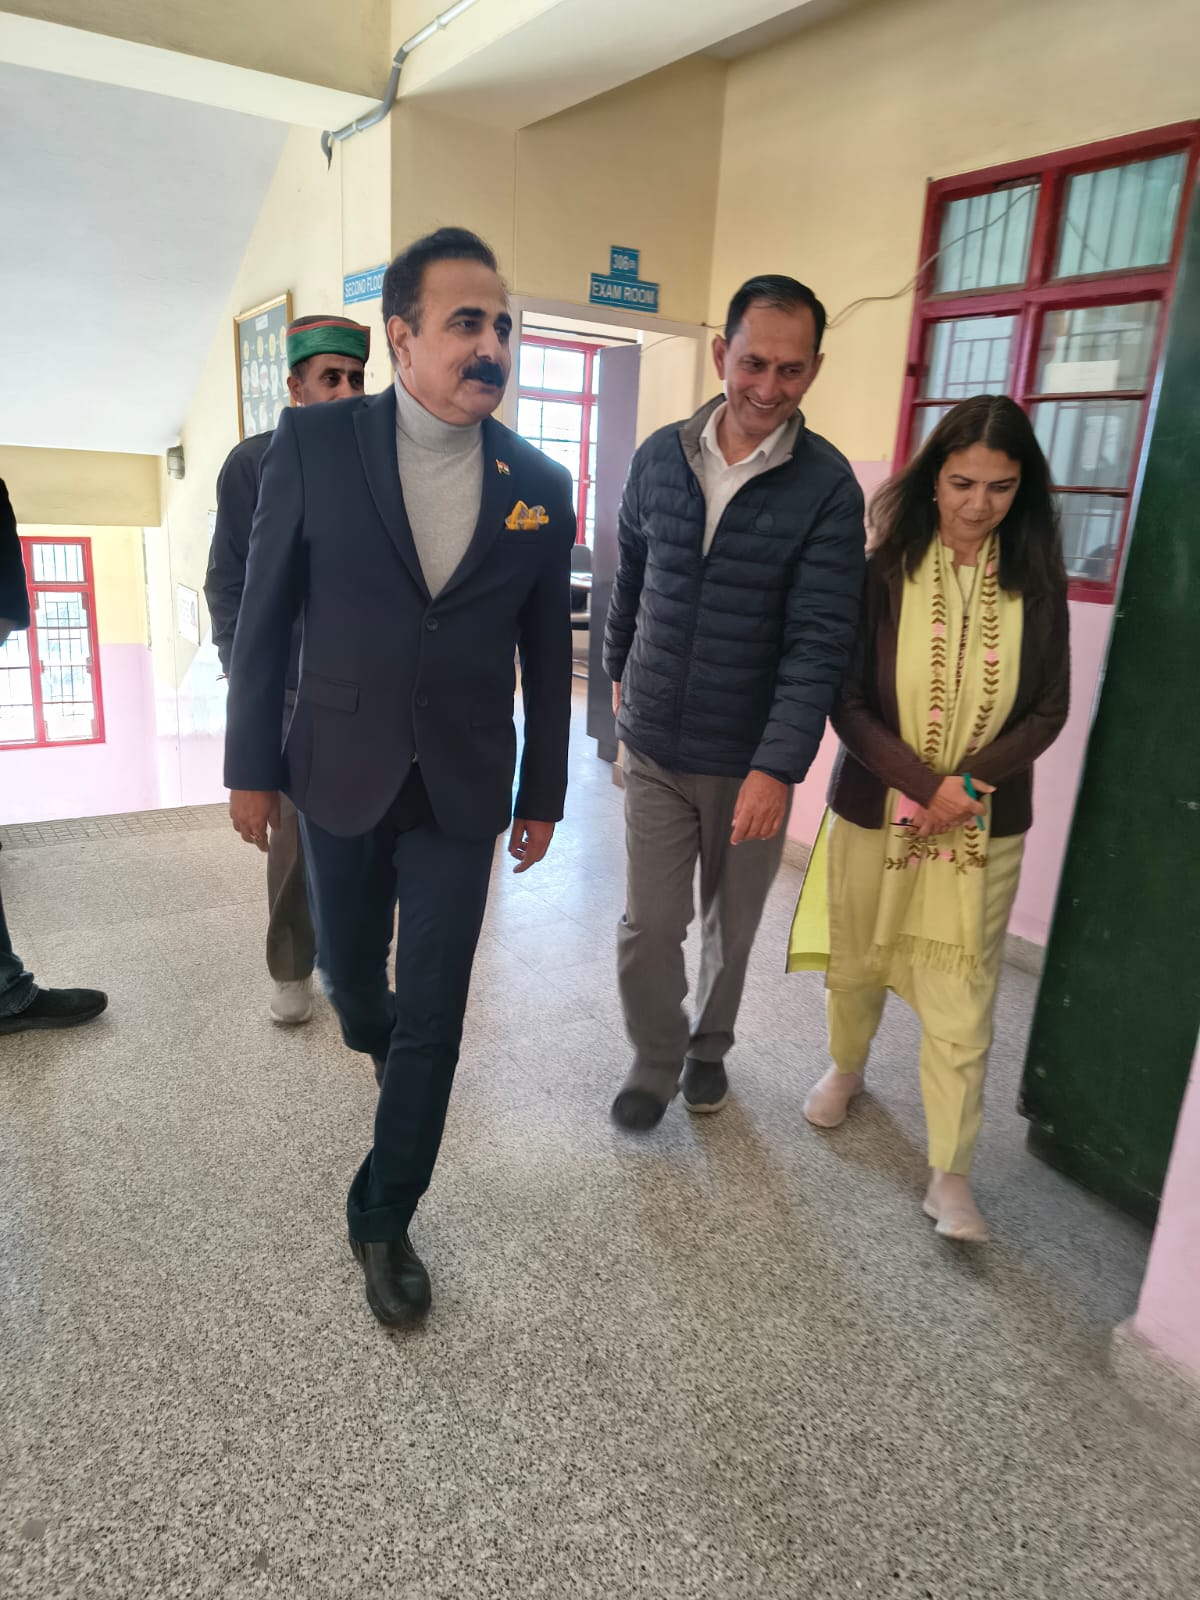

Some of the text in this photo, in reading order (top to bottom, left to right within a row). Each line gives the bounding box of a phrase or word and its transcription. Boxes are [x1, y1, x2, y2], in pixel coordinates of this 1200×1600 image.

[344, 273, 383, 298] SECOND FLOO
[591, 281, 655, 304] EXAM ROOM
